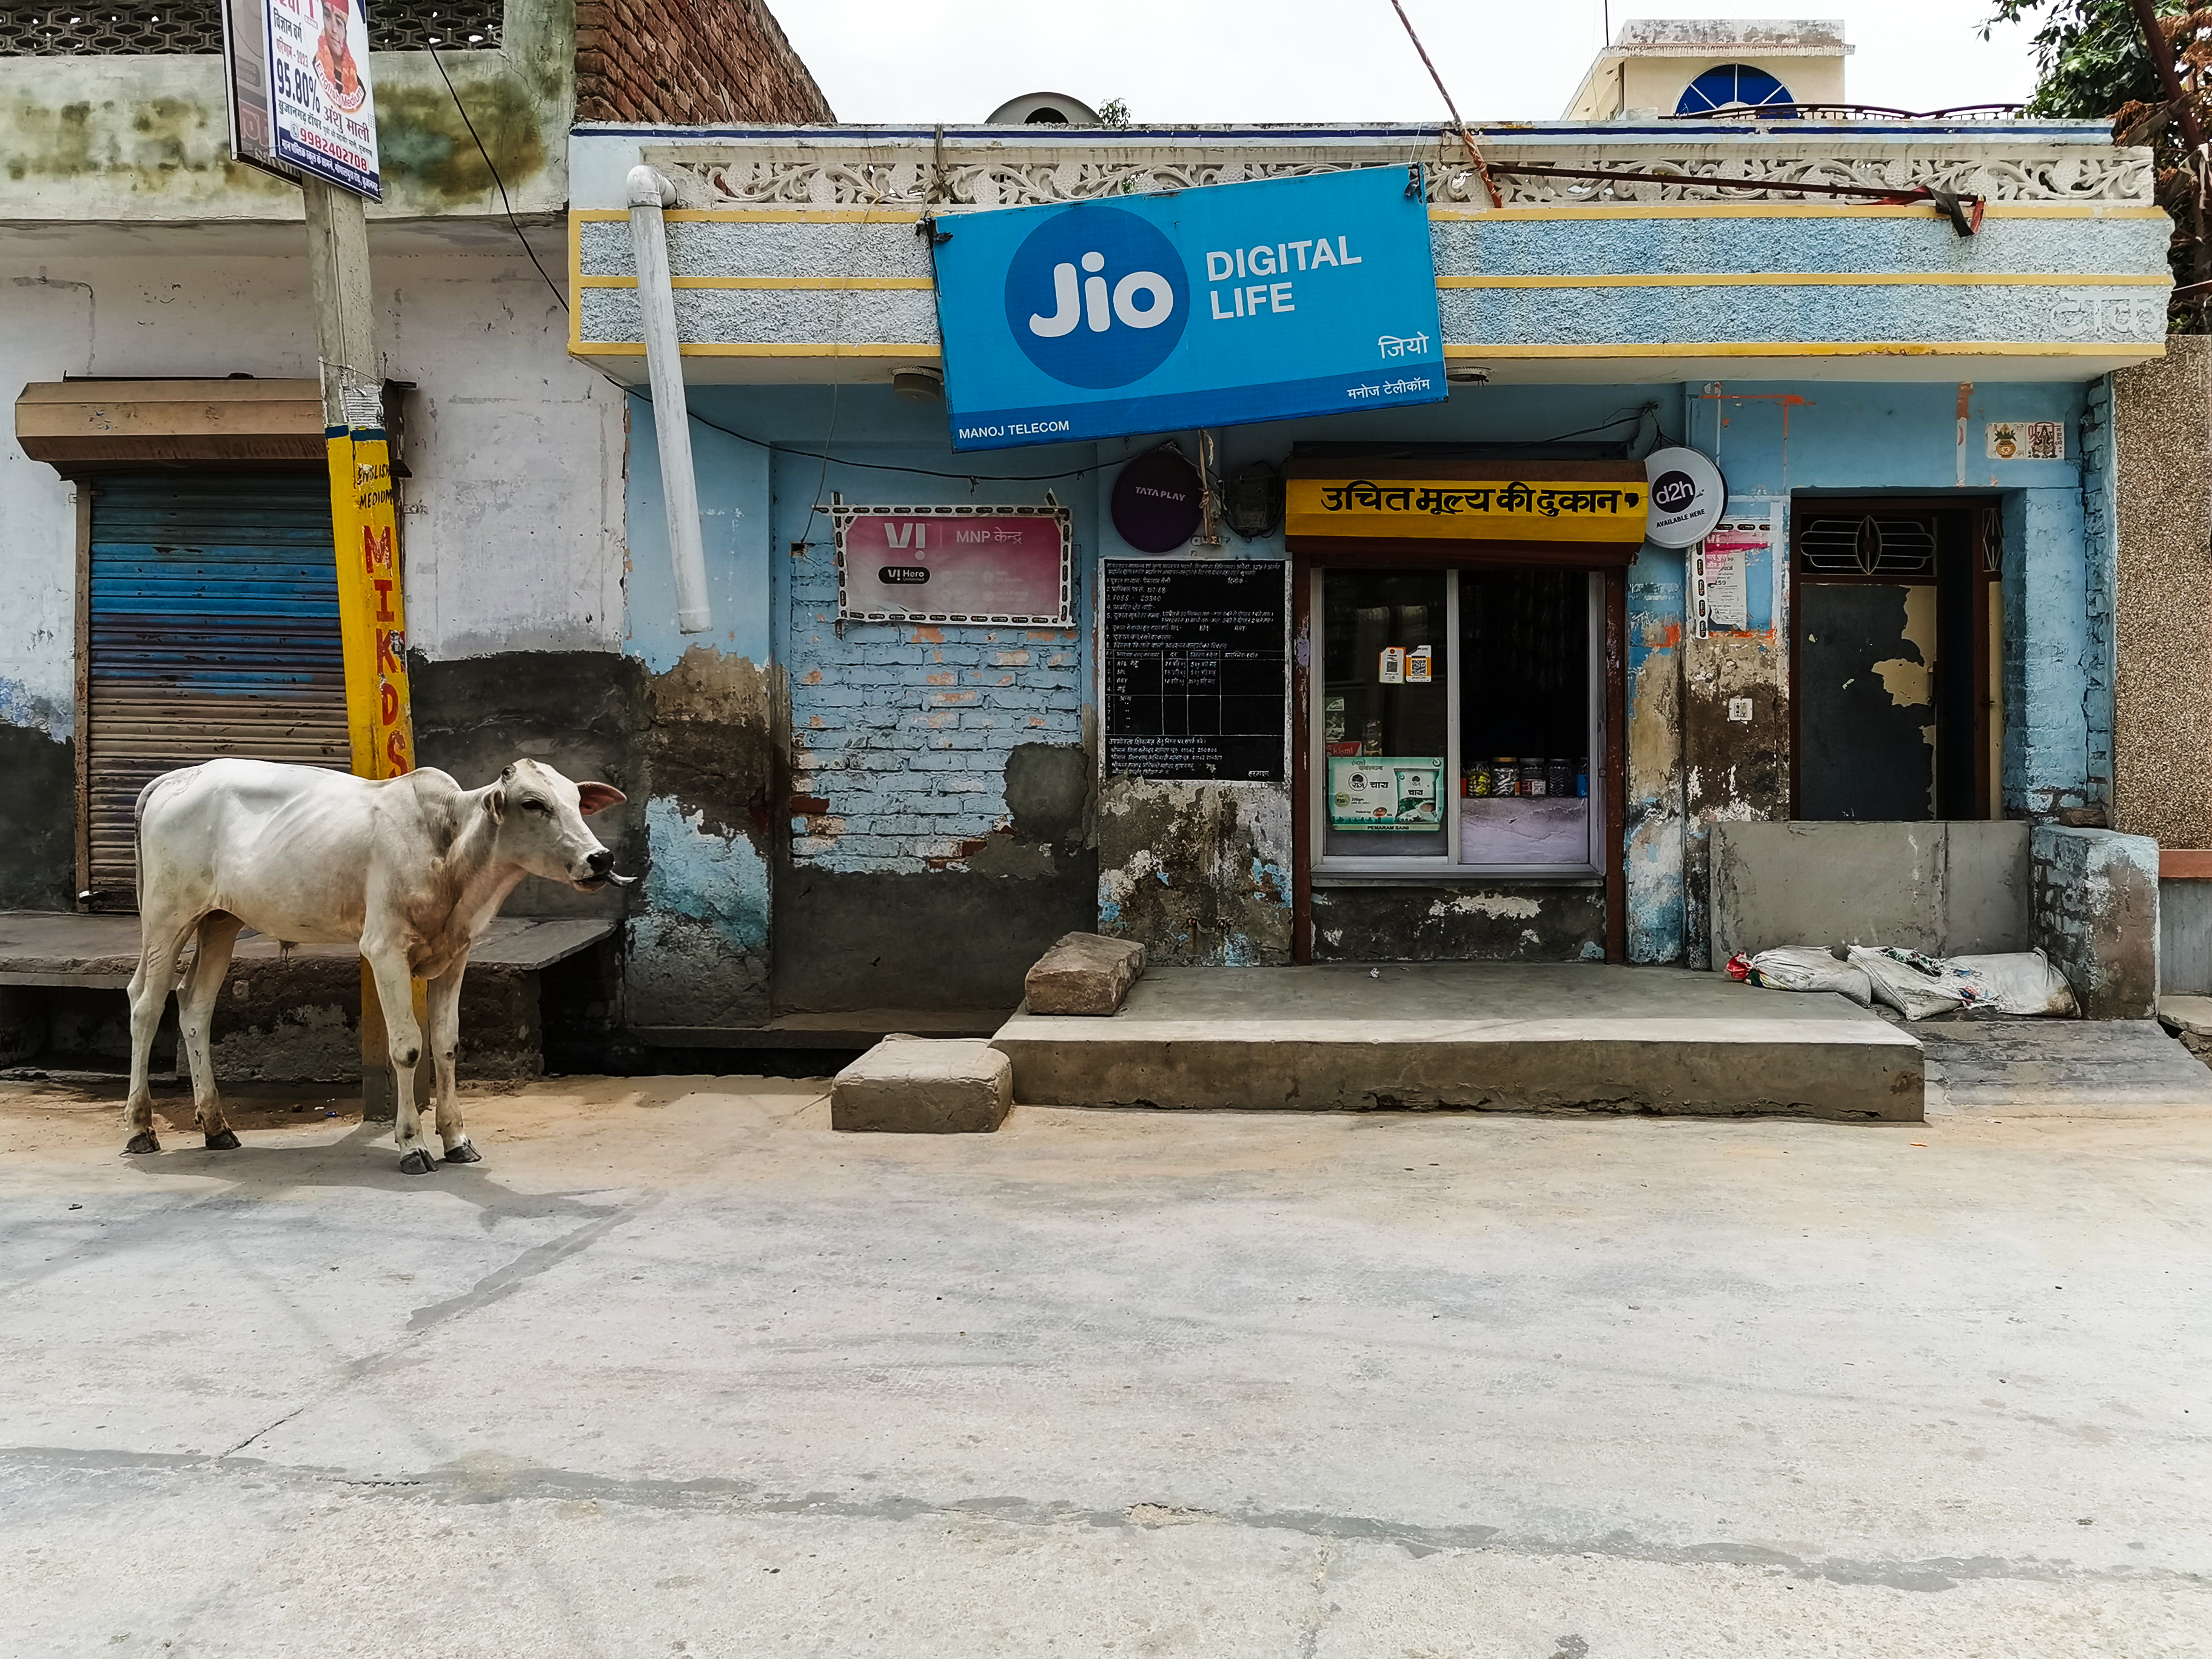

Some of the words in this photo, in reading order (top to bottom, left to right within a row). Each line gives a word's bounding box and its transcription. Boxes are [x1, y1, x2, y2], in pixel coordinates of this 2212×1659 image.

[277, 58, 320, 113] 95.80%
[316, 62, 340, 104] English
[341, 87, 364, 108] Medium
[307, 112, 322, 130] टॉपर
[324, 105, 344, 133] अंशु
[345, 117, 370, 143] माली
[300, 127, 367, 172] 9982402708
[1205, 235, 1362, 282] DIGITAL
[1029, 252, 1175, 338] Jio
[1210, 282, 1296, 320] LIFE
[1378, 332, 1430, 360] जियो
[1347, 380, 1380, 400] मनोज
[1383, 377, 1431, 398] टेलीकॉम
[959, 424, 1005, 440] MANOJ
[1007, 420, 1070, 436] TELECOM
[360, 489, 393, 509] MEDIUM
[1135, 486, 1159, 497] TATA
[1160, 491, 1186, 501] PLAY
[1321, 480, 1415, 512] उचित
[1416, 487, 1496, 516] मूल्य
[1498, 480, 1533, 513] की
[1536, 488, 1620, 518] दुकान
[1656, 481, 1694, 504] d2h
[1656, 514, 1689, 528] AVAILABLE
[1689, 508, 1706, 520] HERE
[956, 530, 991, 544] MNP
[993, 526, 1023, 545] केन्द्र
[903, 569, 925, 578] Hero
